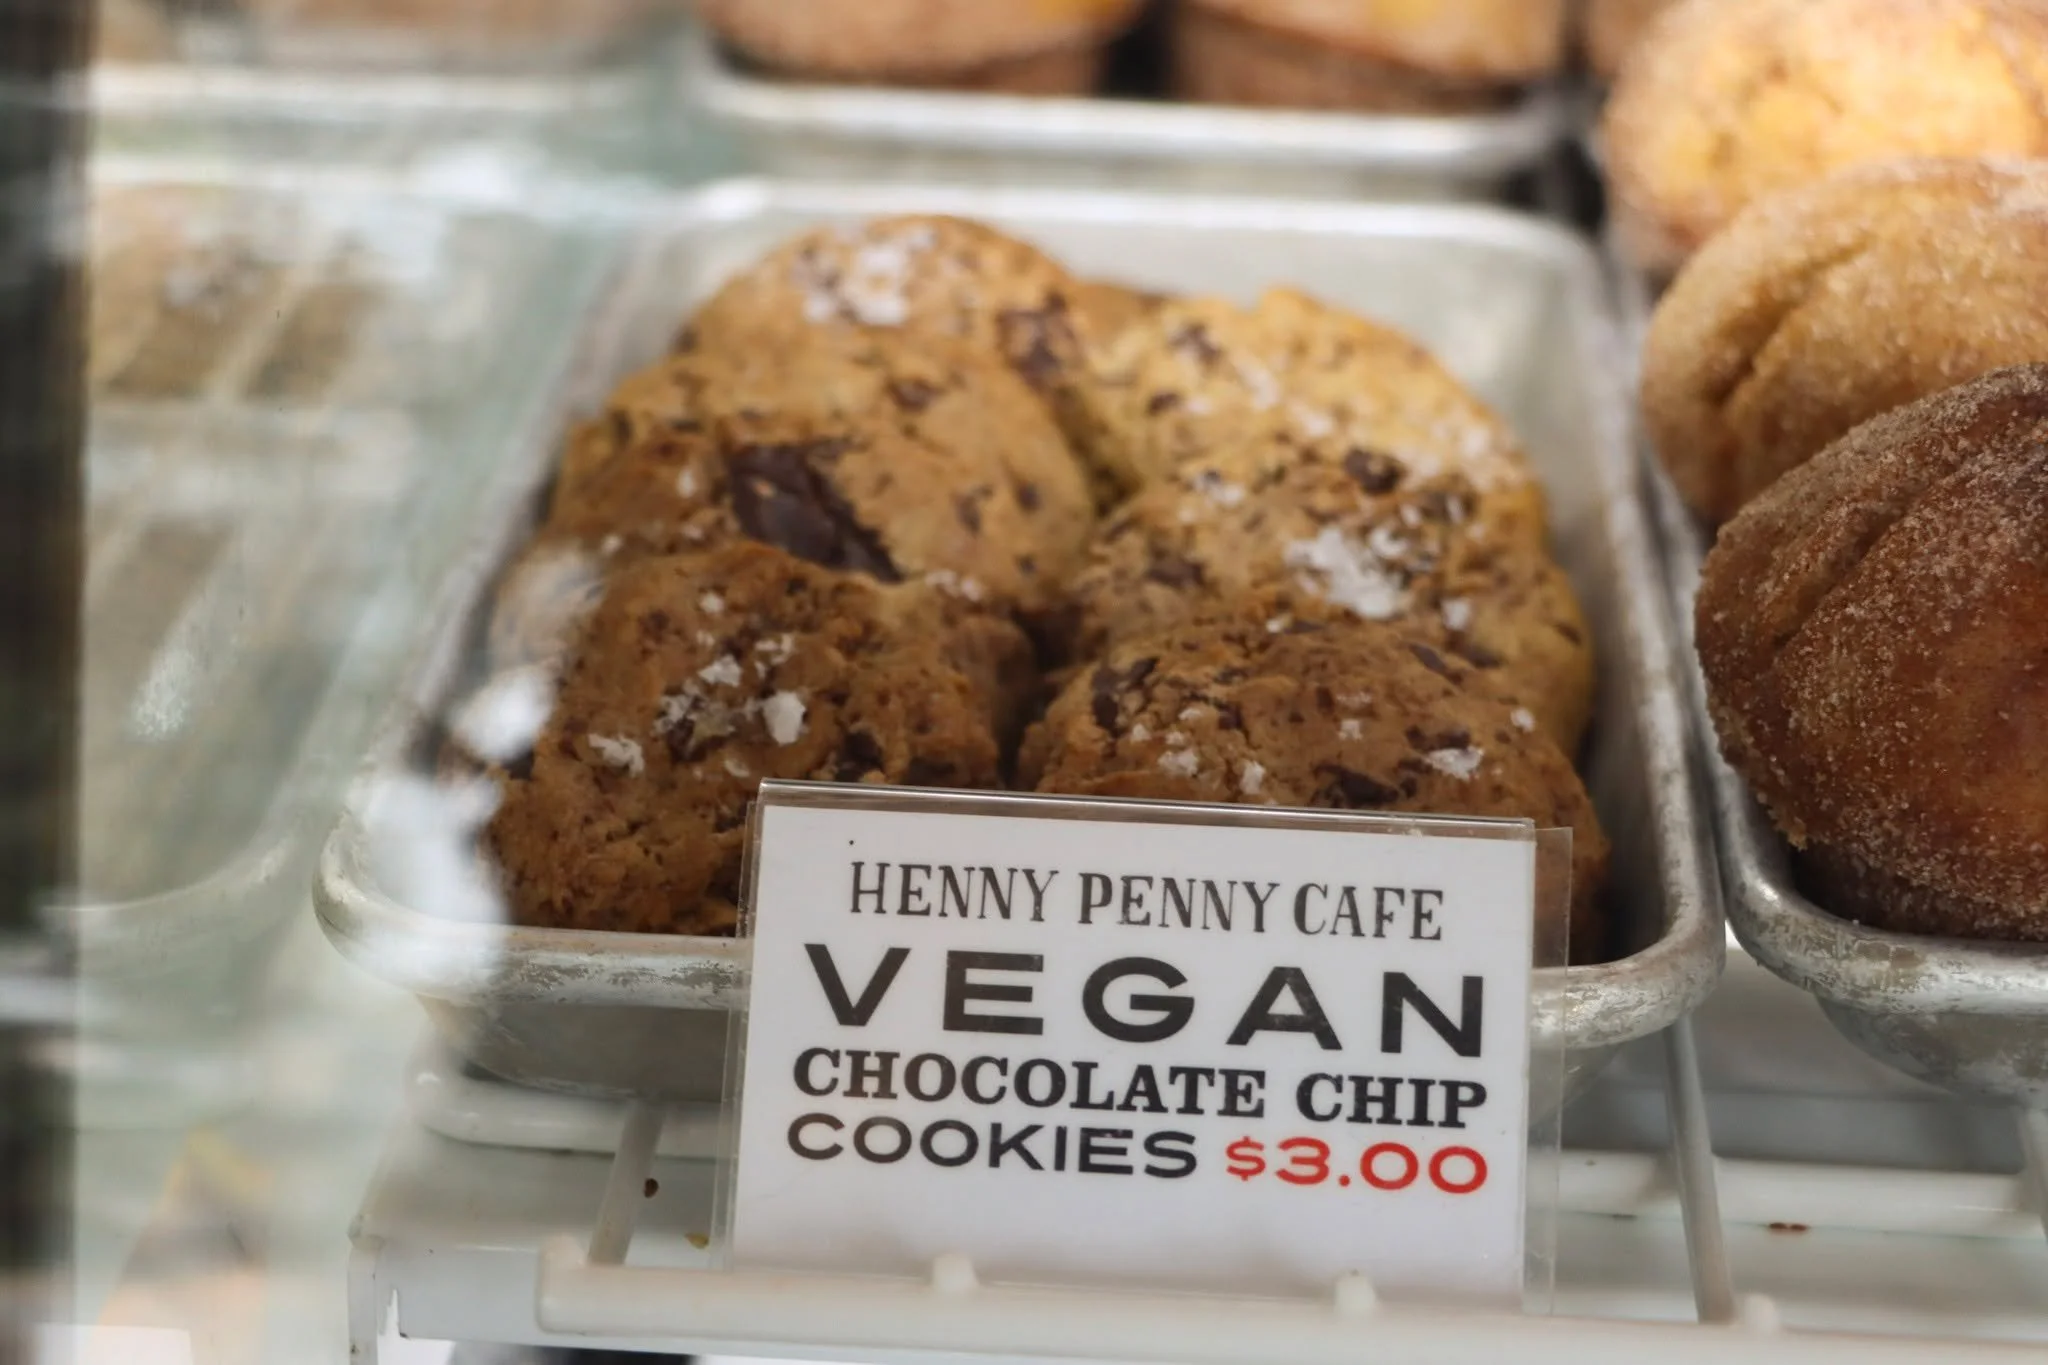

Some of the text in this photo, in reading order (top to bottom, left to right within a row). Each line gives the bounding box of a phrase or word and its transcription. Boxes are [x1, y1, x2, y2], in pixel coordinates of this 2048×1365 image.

[850, 861, 1444, 941] HENNY PENNY CAFE
[803, 943, 1484, 1058] VEGAN
[793, 1047, 1488, 1129] CHOCOLATE CHIP
[787, 1112, 1488, 1195] COOKIES $3.00
